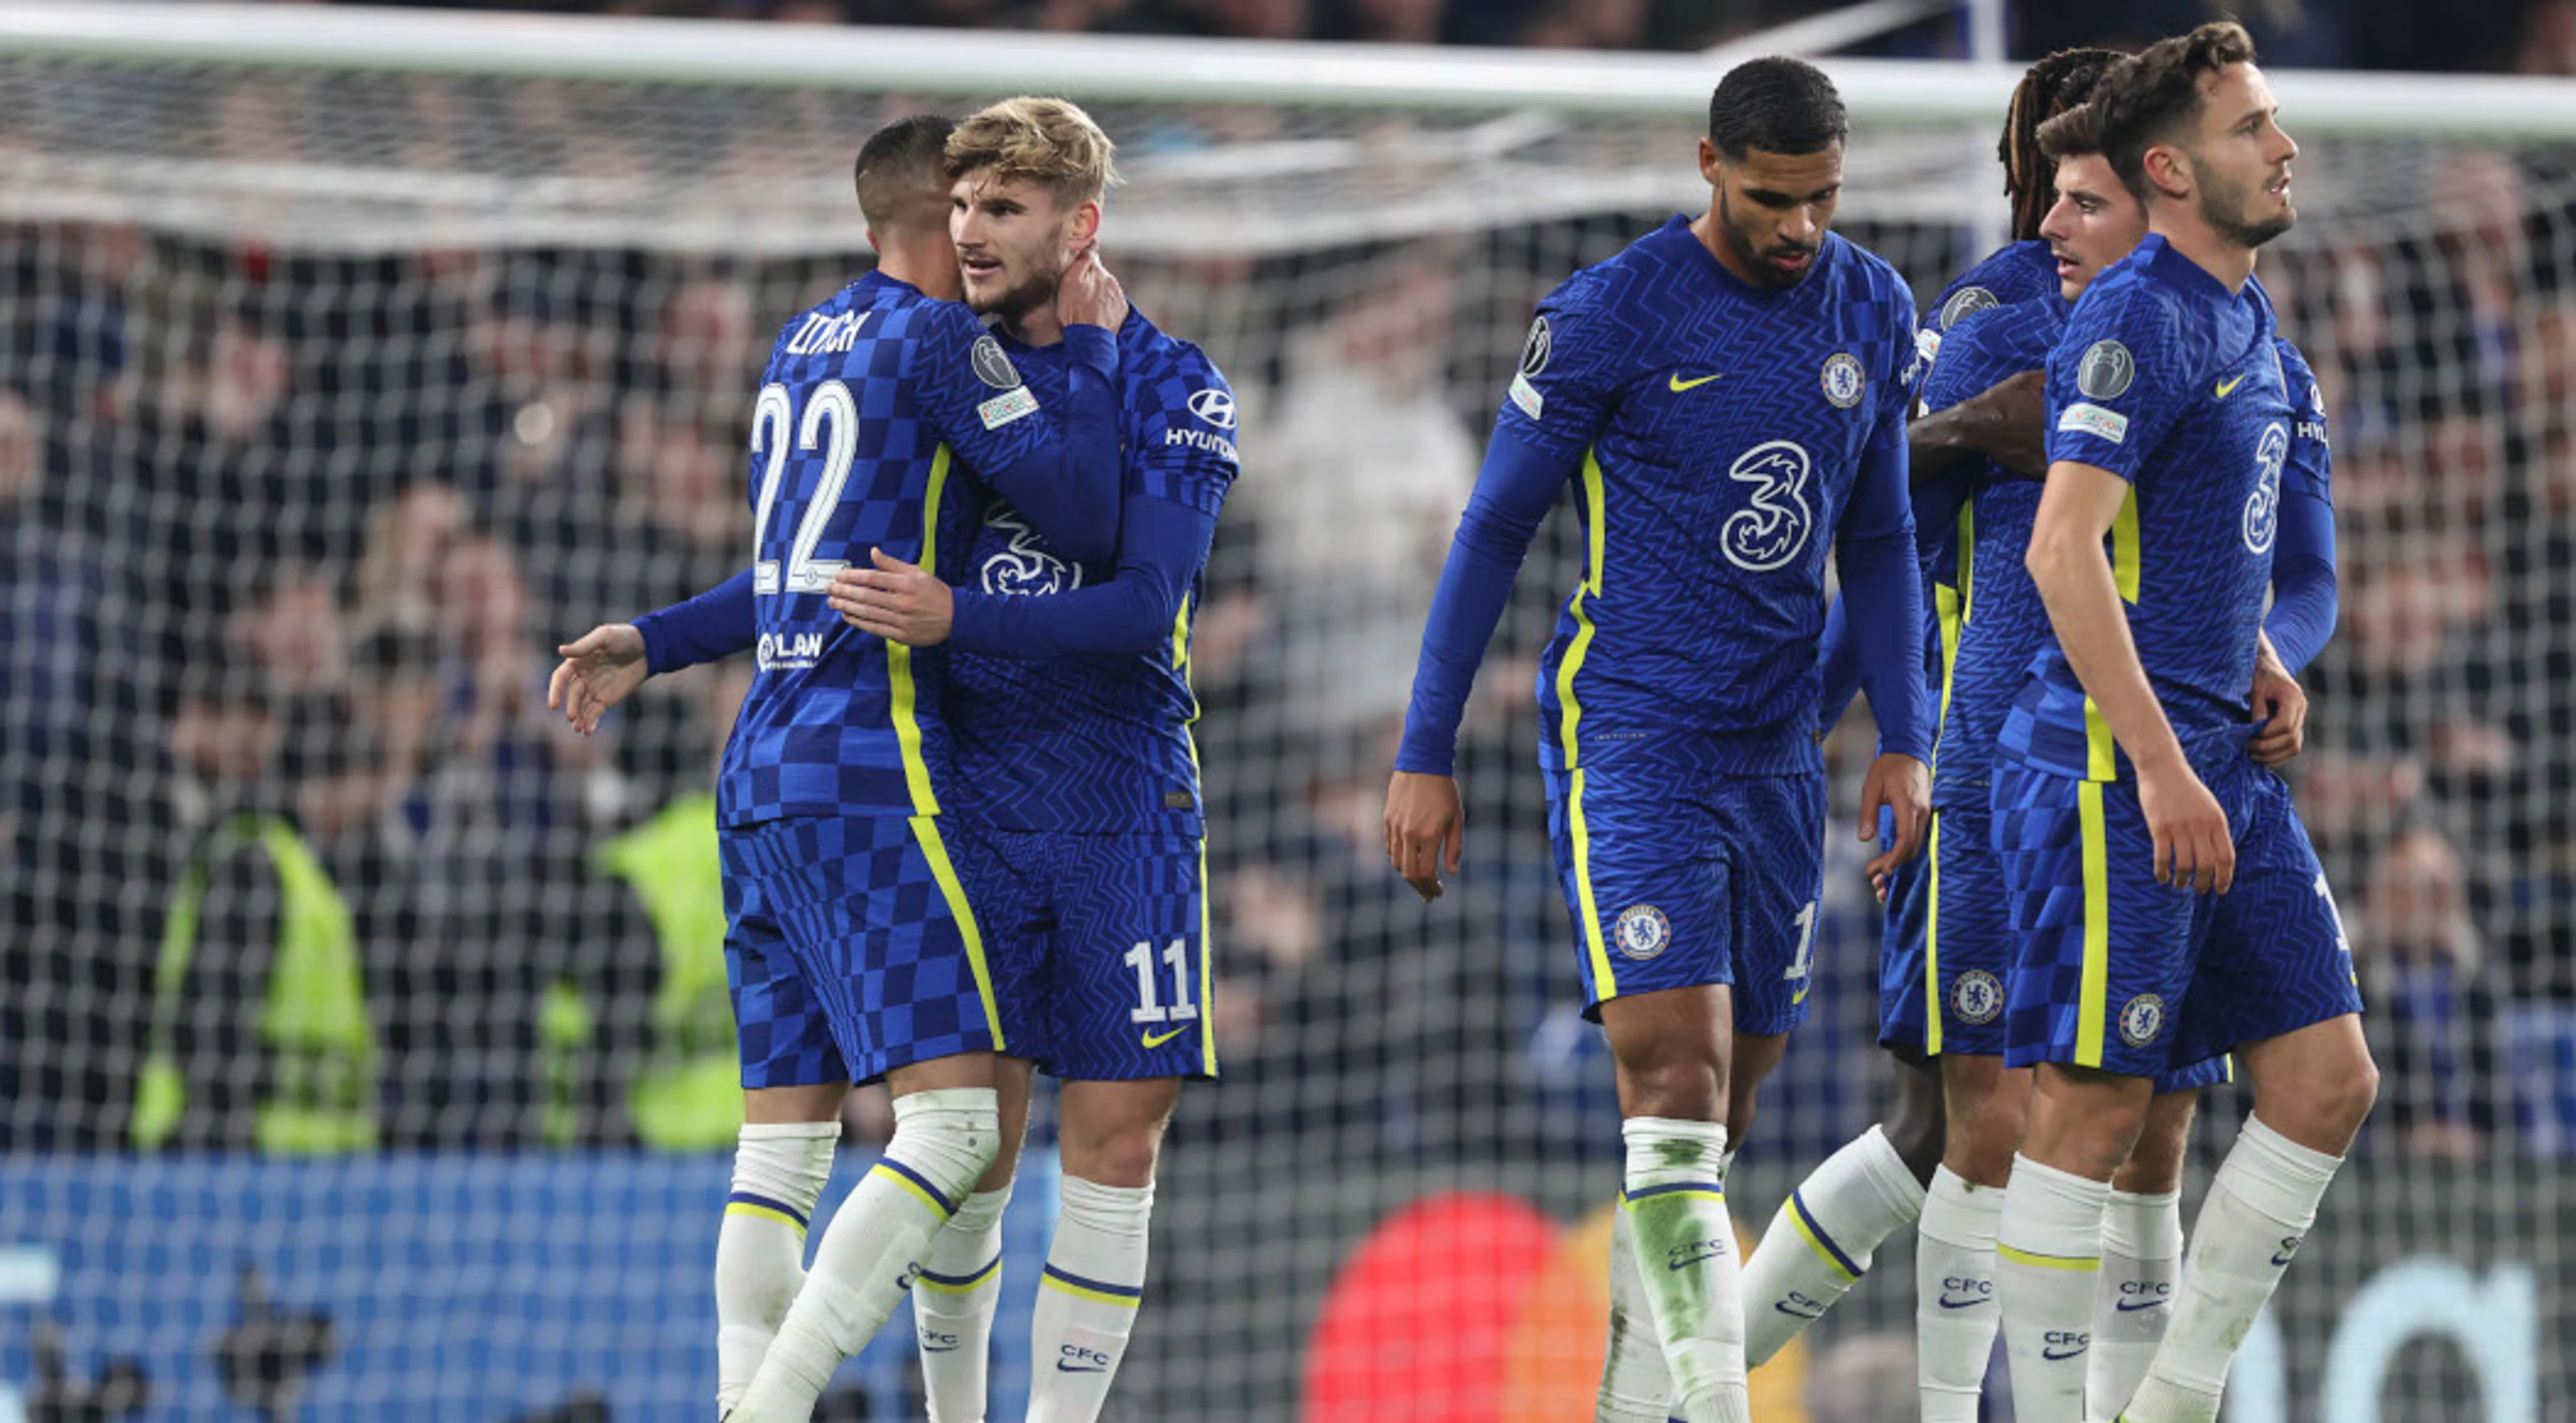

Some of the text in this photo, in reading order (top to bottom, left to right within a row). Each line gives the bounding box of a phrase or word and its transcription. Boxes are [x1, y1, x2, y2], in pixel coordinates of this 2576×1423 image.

[751, 380, 860, 596] 22
[1720, 440, 1811, 571] 3
[1783, 900, 1815, 980] 1
[1124, 938, 1198, 1022] 11
[1943, 1276, 1993, 1294] CFC
[2119, 1280, 2169, 1296] CFC
[1061, 1344, 1110, 1366] CFC
[2043, 1330, 2090, 1346] CFC
